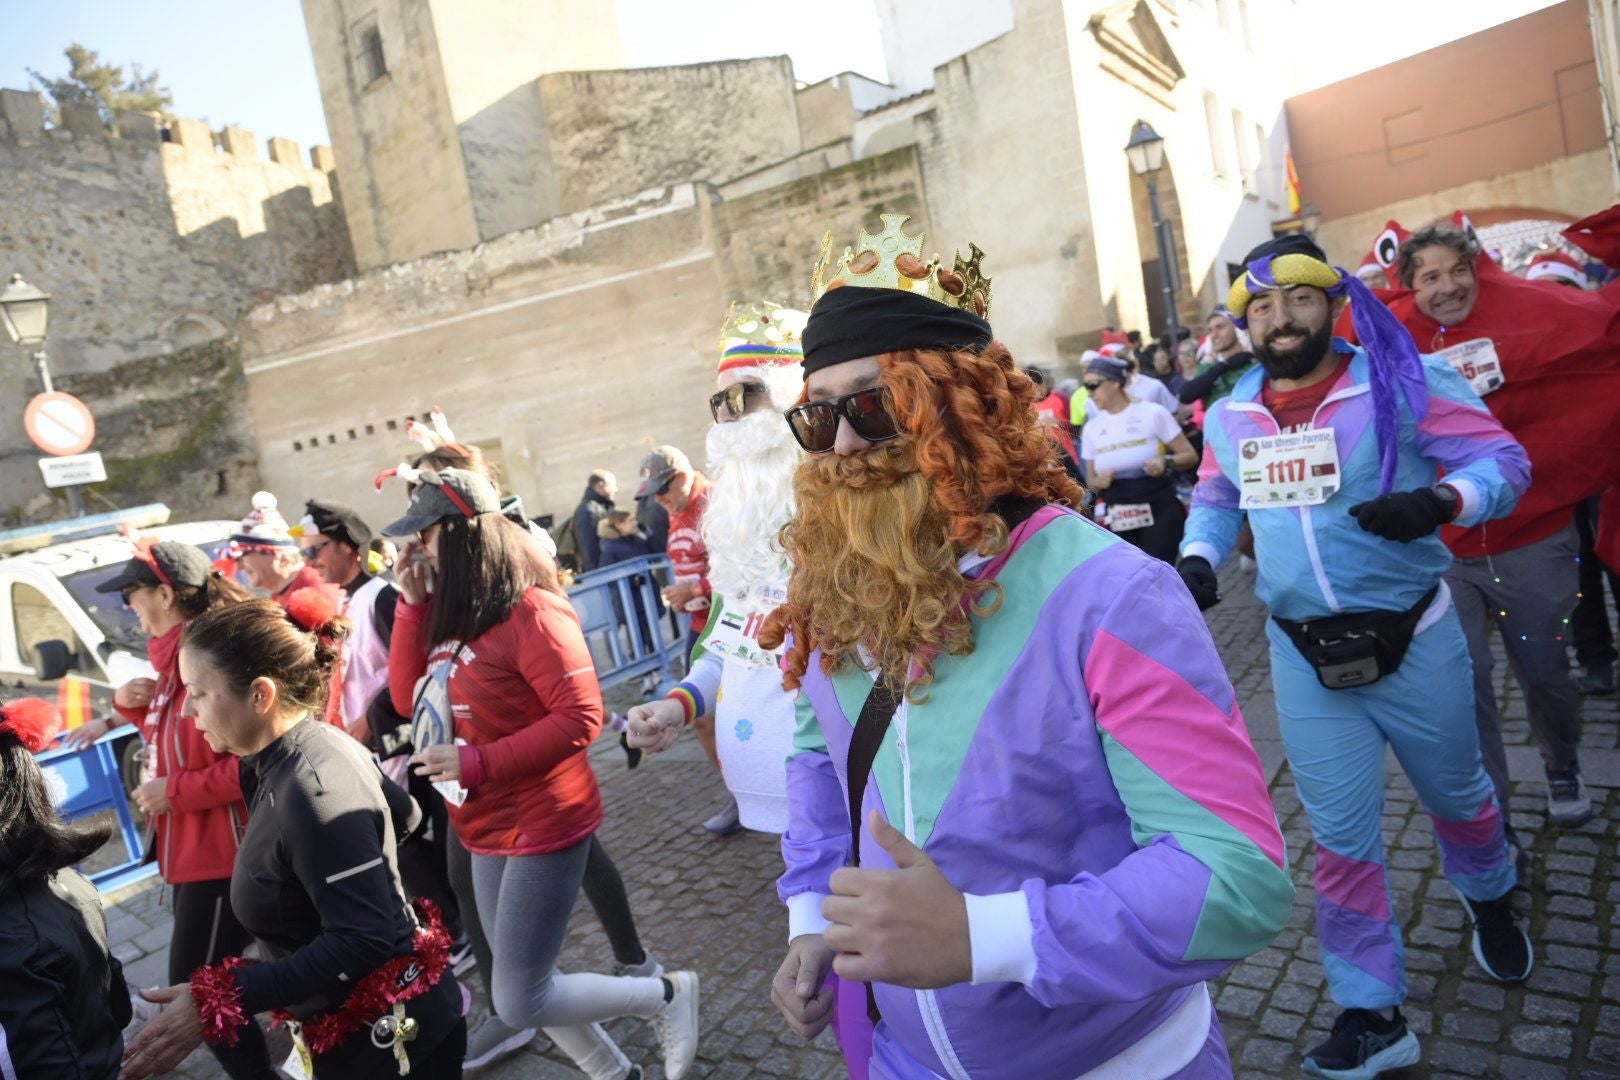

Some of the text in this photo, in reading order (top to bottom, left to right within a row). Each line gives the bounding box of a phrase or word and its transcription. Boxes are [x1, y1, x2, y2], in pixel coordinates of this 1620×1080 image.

[1274, 436, 1301, 448] Silvestre
[1302, 431, 1331, 444] Pacense
[1265, 458, 1305, 484] 1117
[742, 610, 765, 639] 11
